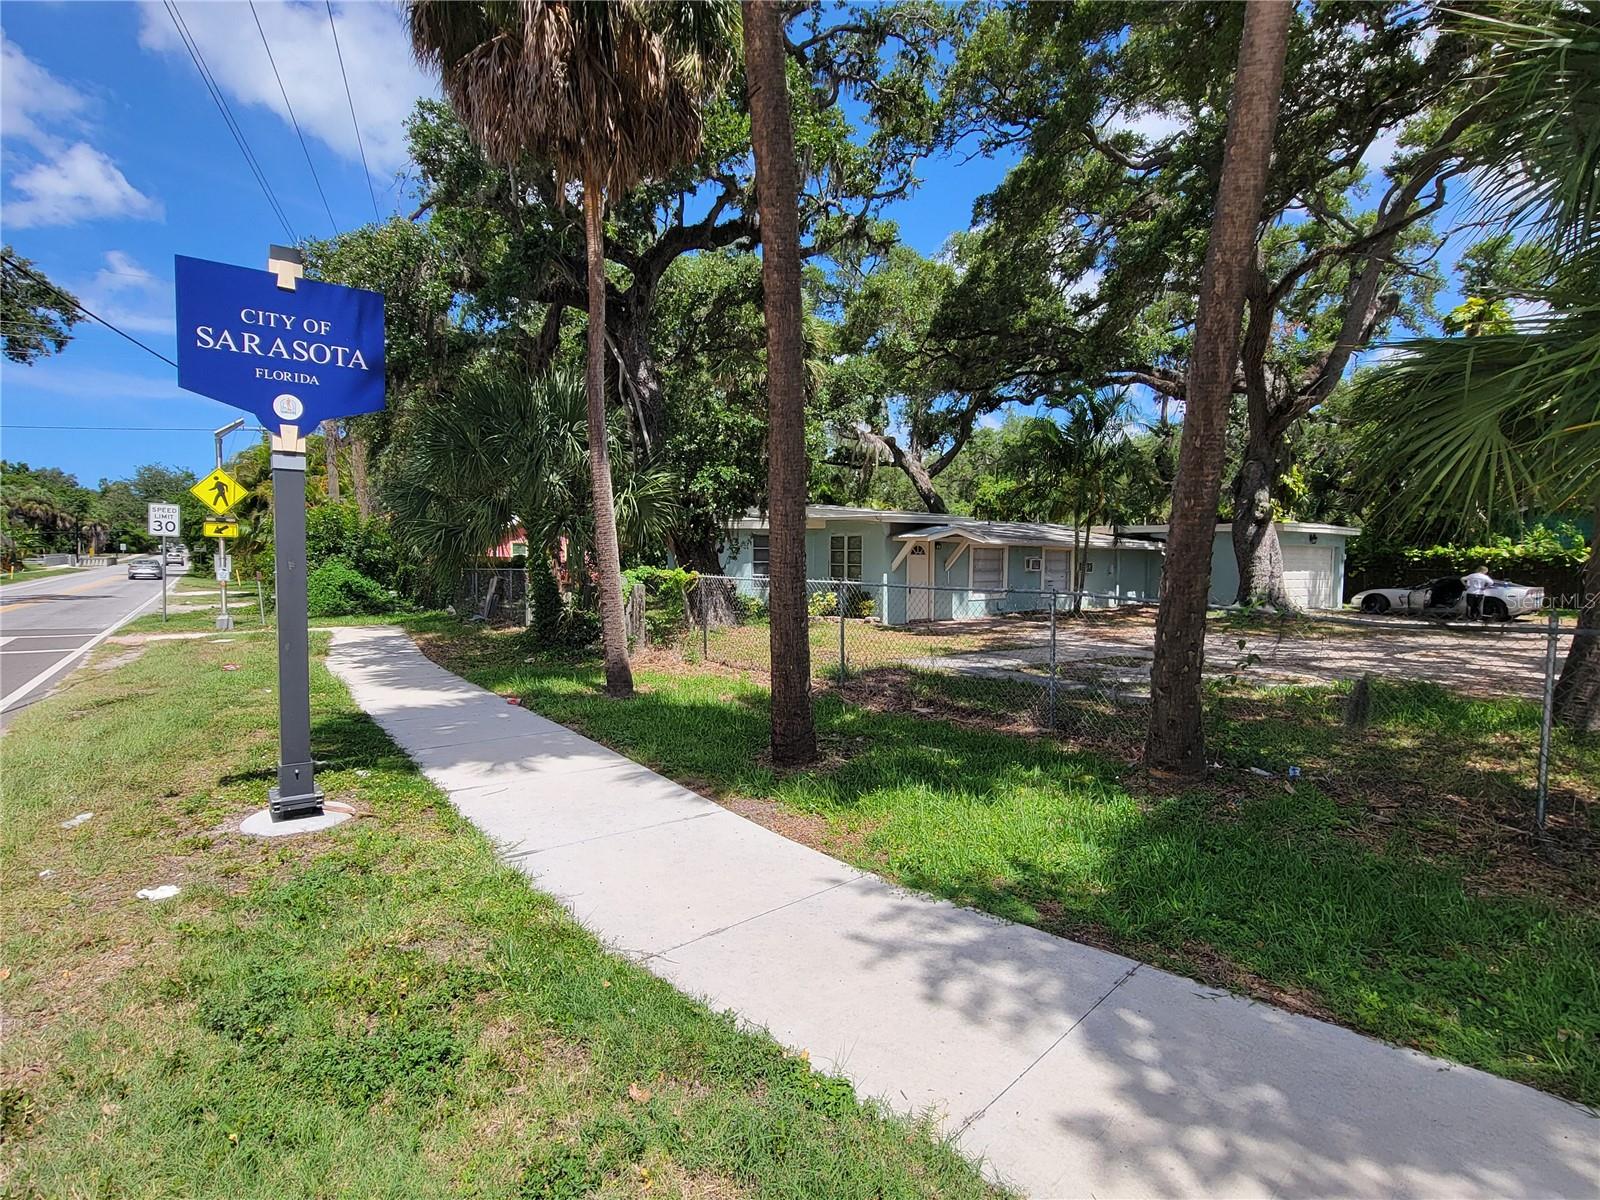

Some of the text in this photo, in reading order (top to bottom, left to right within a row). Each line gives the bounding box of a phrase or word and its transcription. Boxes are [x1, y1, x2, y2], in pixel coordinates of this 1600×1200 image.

[240, 308, 331, 336] CITY OF
[196, 325, 369, 370] SARASOTA
[255, 367, 320, 386] FLORIDA
[153, 520, 176, 532] 30
